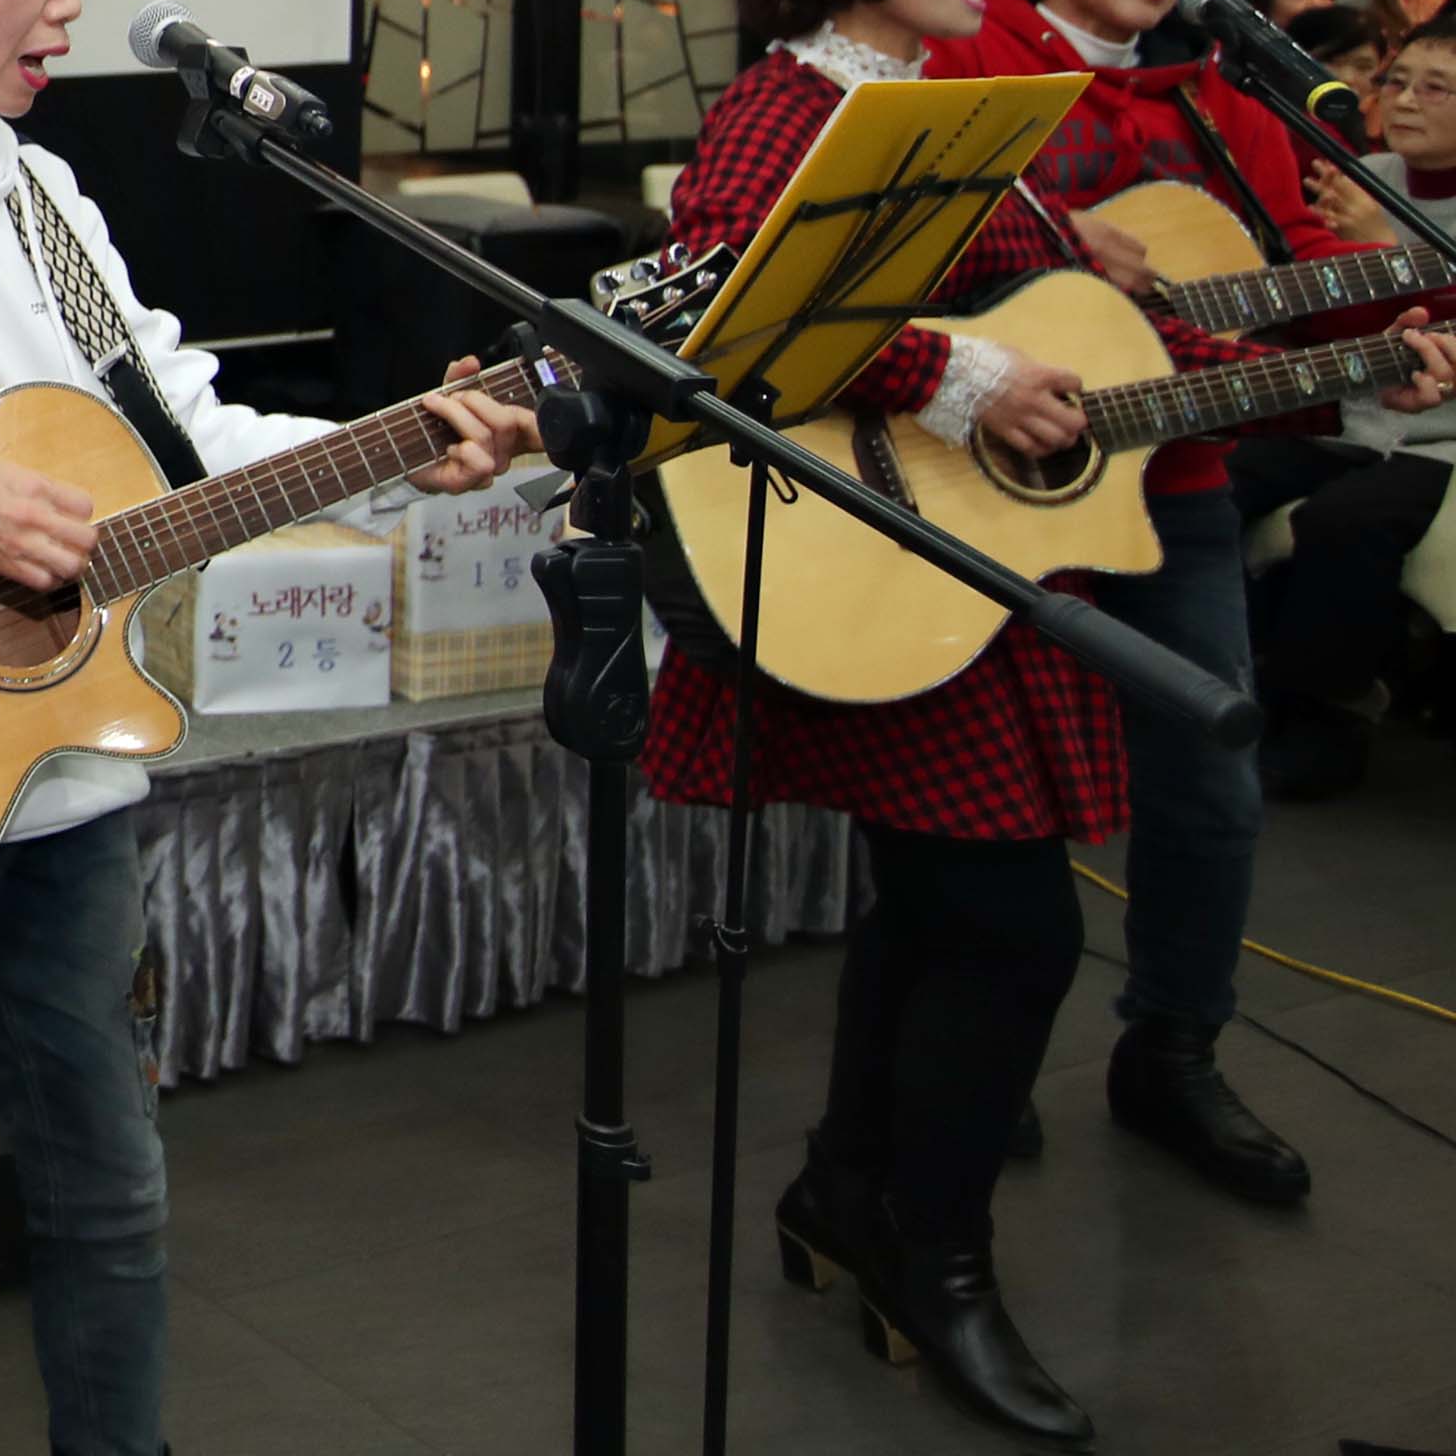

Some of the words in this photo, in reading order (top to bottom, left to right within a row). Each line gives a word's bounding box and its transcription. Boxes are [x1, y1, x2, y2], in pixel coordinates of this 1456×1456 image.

[247, 582, 359, 620] 노래자랑
[277, 640, 295, 670] 2
[312, 637, 341, 673] 등
